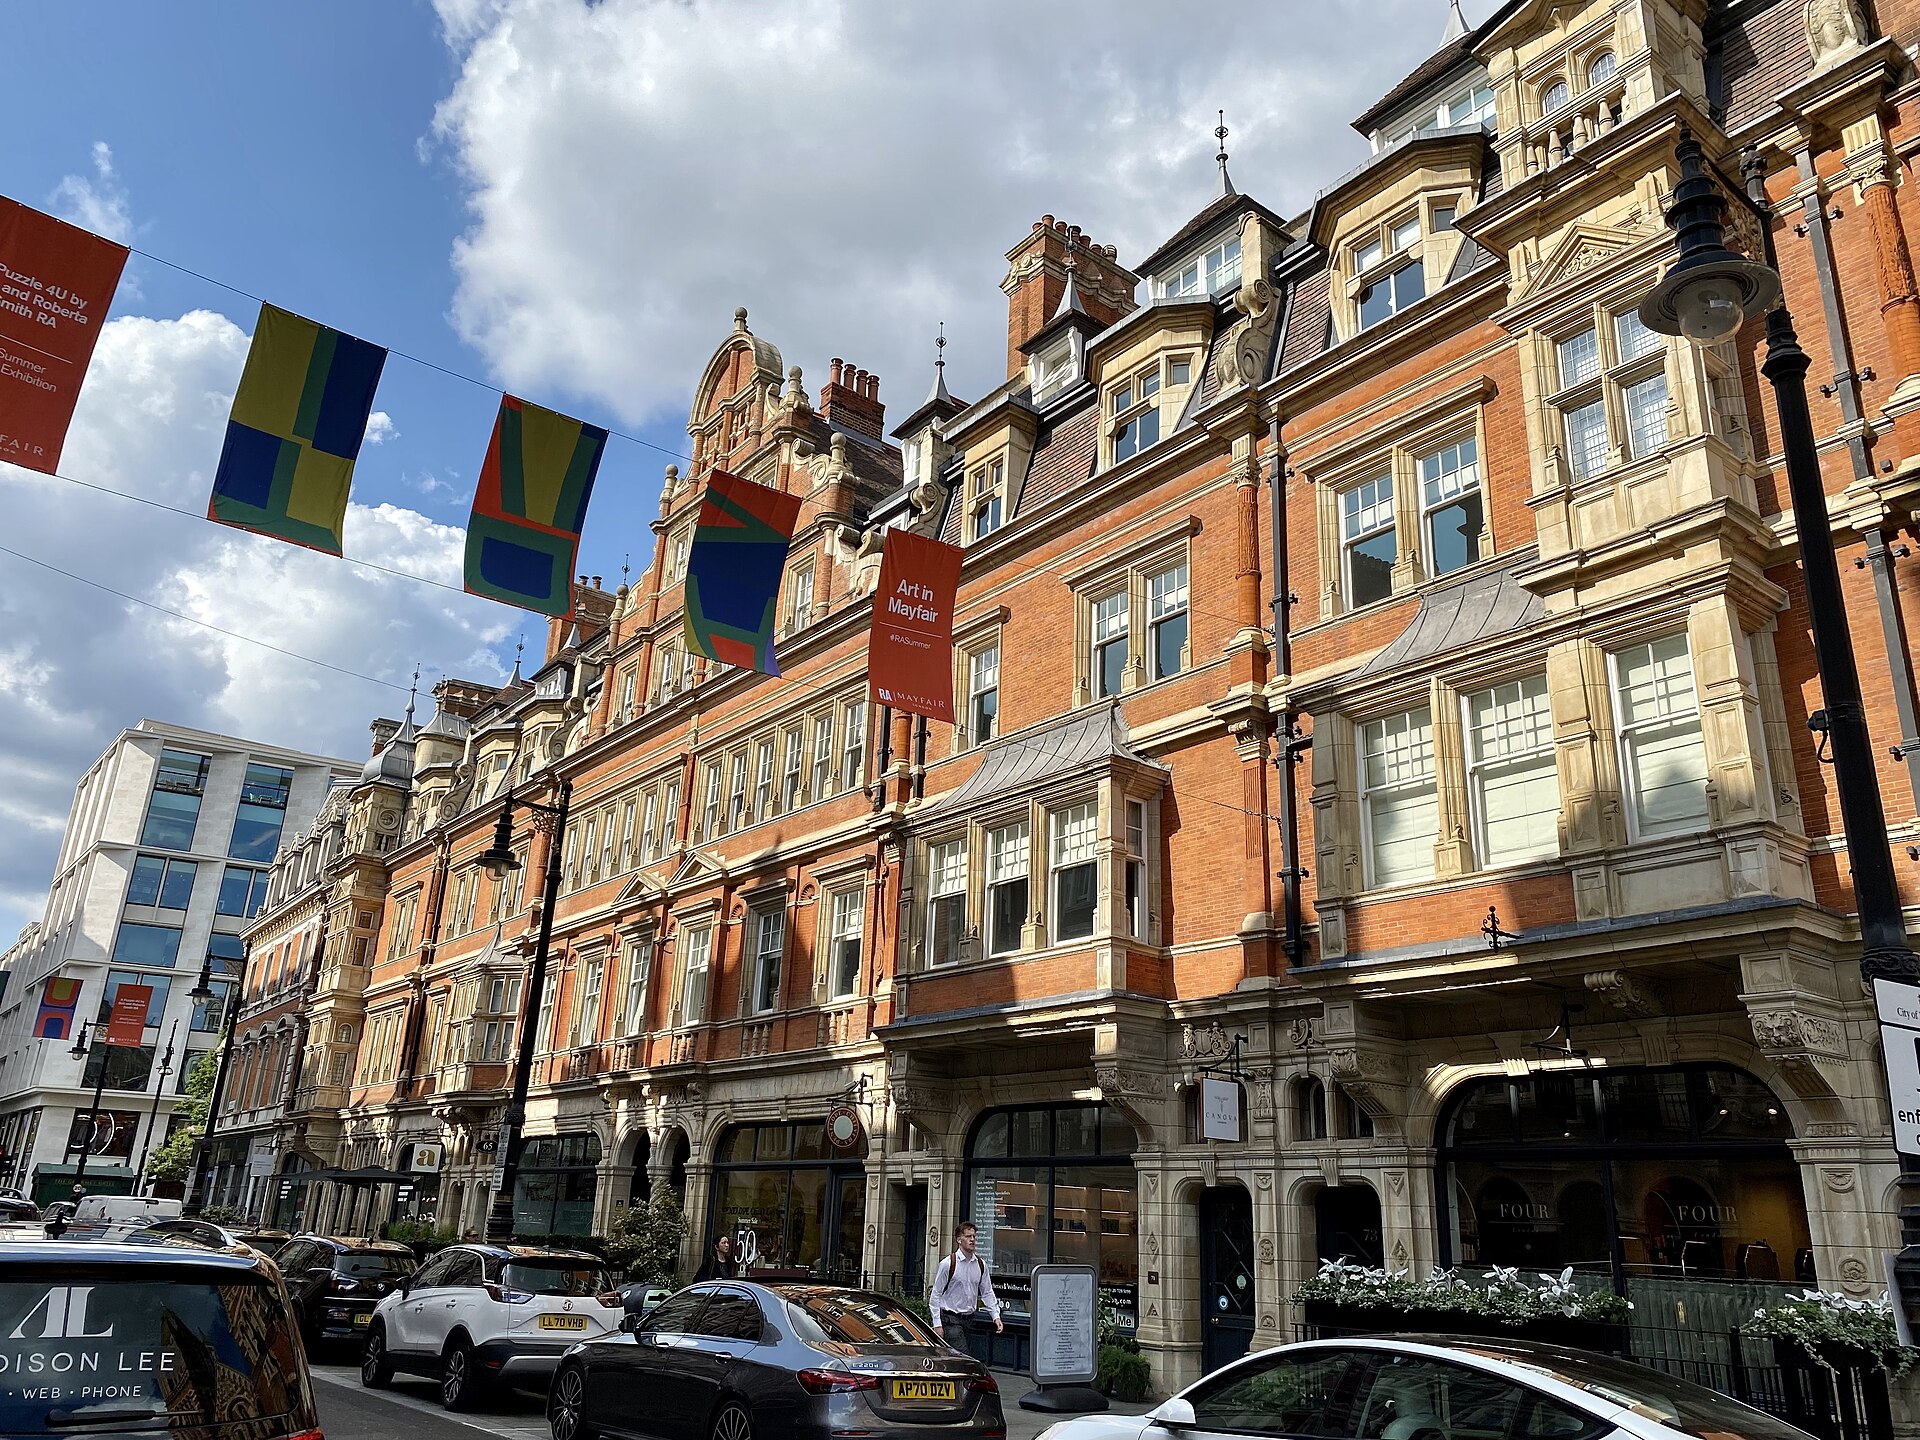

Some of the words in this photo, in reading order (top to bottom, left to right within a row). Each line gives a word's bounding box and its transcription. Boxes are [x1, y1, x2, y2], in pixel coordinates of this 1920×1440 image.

[1, 284, 31, 301] and
[32, 294, 88, 324] Roberta
[45, 285, 68, 300] 4U
[70, 293, 88, 309] by
[0, 296, 33, 319] mith
[36, 311, 56, 329] RA
[1, 363, 57, 393] Exhibition
[0, 434, 43, 456] FAIR
[896, 579, 920, 598] Art
[921, 584, 934, 602] in
[888, 596, 939, 623] Mayfair
[889, 633, 931, 649] #RASummer
[878, 687, 893, 702] RA
[897, 691, 945, 708] MAYFAIR
[1896, 1006, 1911, 1020] City
[1911, 1011, 1918, 1020] of
[1205, 1111, 1238, 1122] CANOVA
[483, 1142, 493, 1151] 65
[416, 1149, 436, 1167] a
[1500, 1203, 1550, 1219] FOUR
[1678, 1205, 1737, 1222] FOUR
[1363, 1228, 1378, 1242] 73
[734, 1230, 757, 1265] 50
[542, 1317, 566, 1327] LL70
[567, 1318, 584, 1328] VHB
[118, 1351, 176, 1372] LEE
[22, 1387, 62, 1400] WEB
[81, 1385, 142, 1398] PHONE
[898, 1382, 928, 1397] AP70
[930, 1383, 951, 1397] DZV
